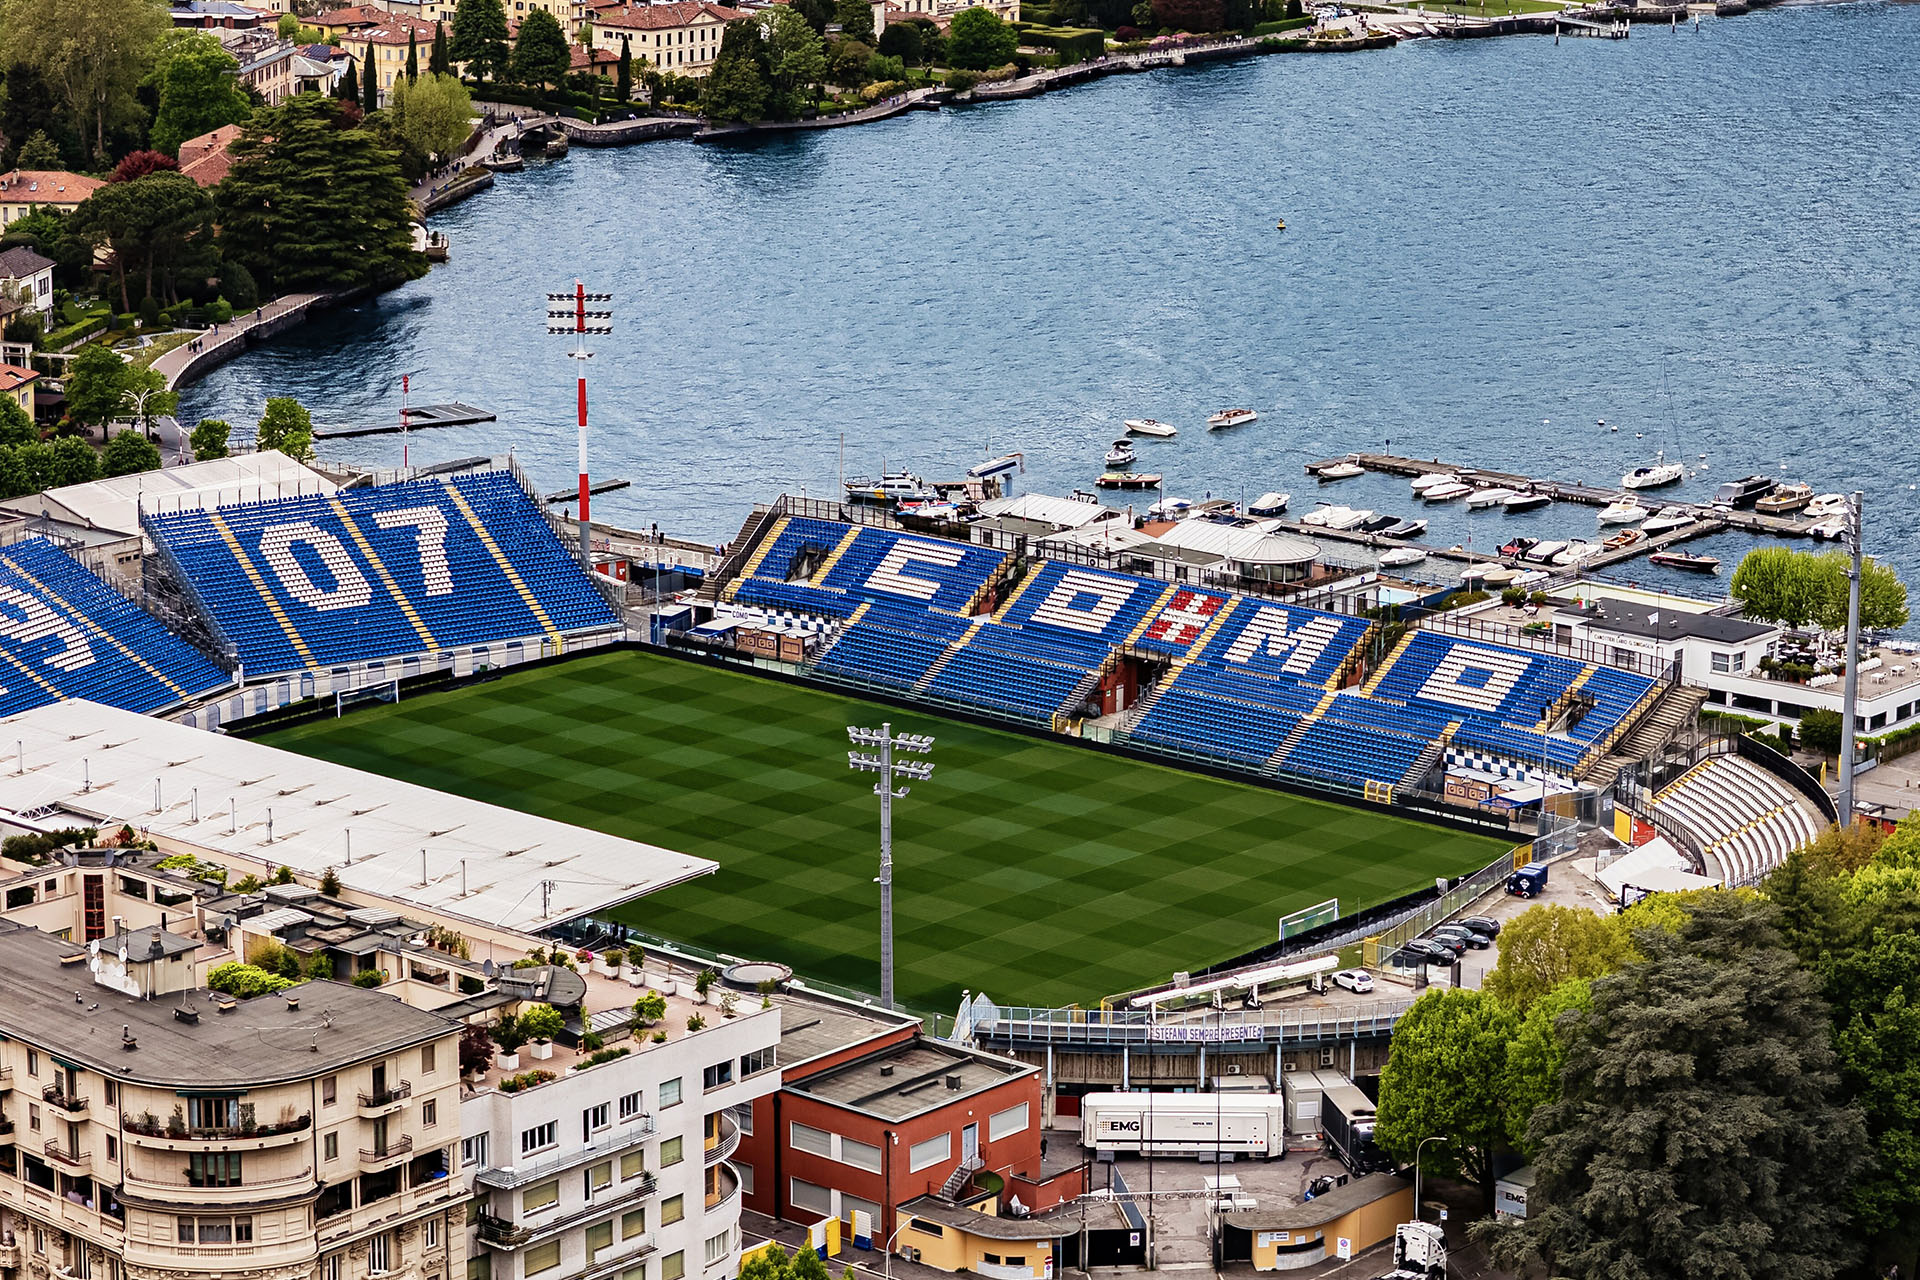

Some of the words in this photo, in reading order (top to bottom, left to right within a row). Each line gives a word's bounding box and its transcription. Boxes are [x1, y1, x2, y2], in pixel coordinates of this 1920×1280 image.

[1155, 1027, 1187, 1040] STEFANO
[1190, 1028, 1218, 1040] SEMPRE
[1221, 1025, 1257, 1040] PRESENTE
[1110, 1121, 1140, 1132] EMG
[1505, 1192, 1525, 1204] EMG
